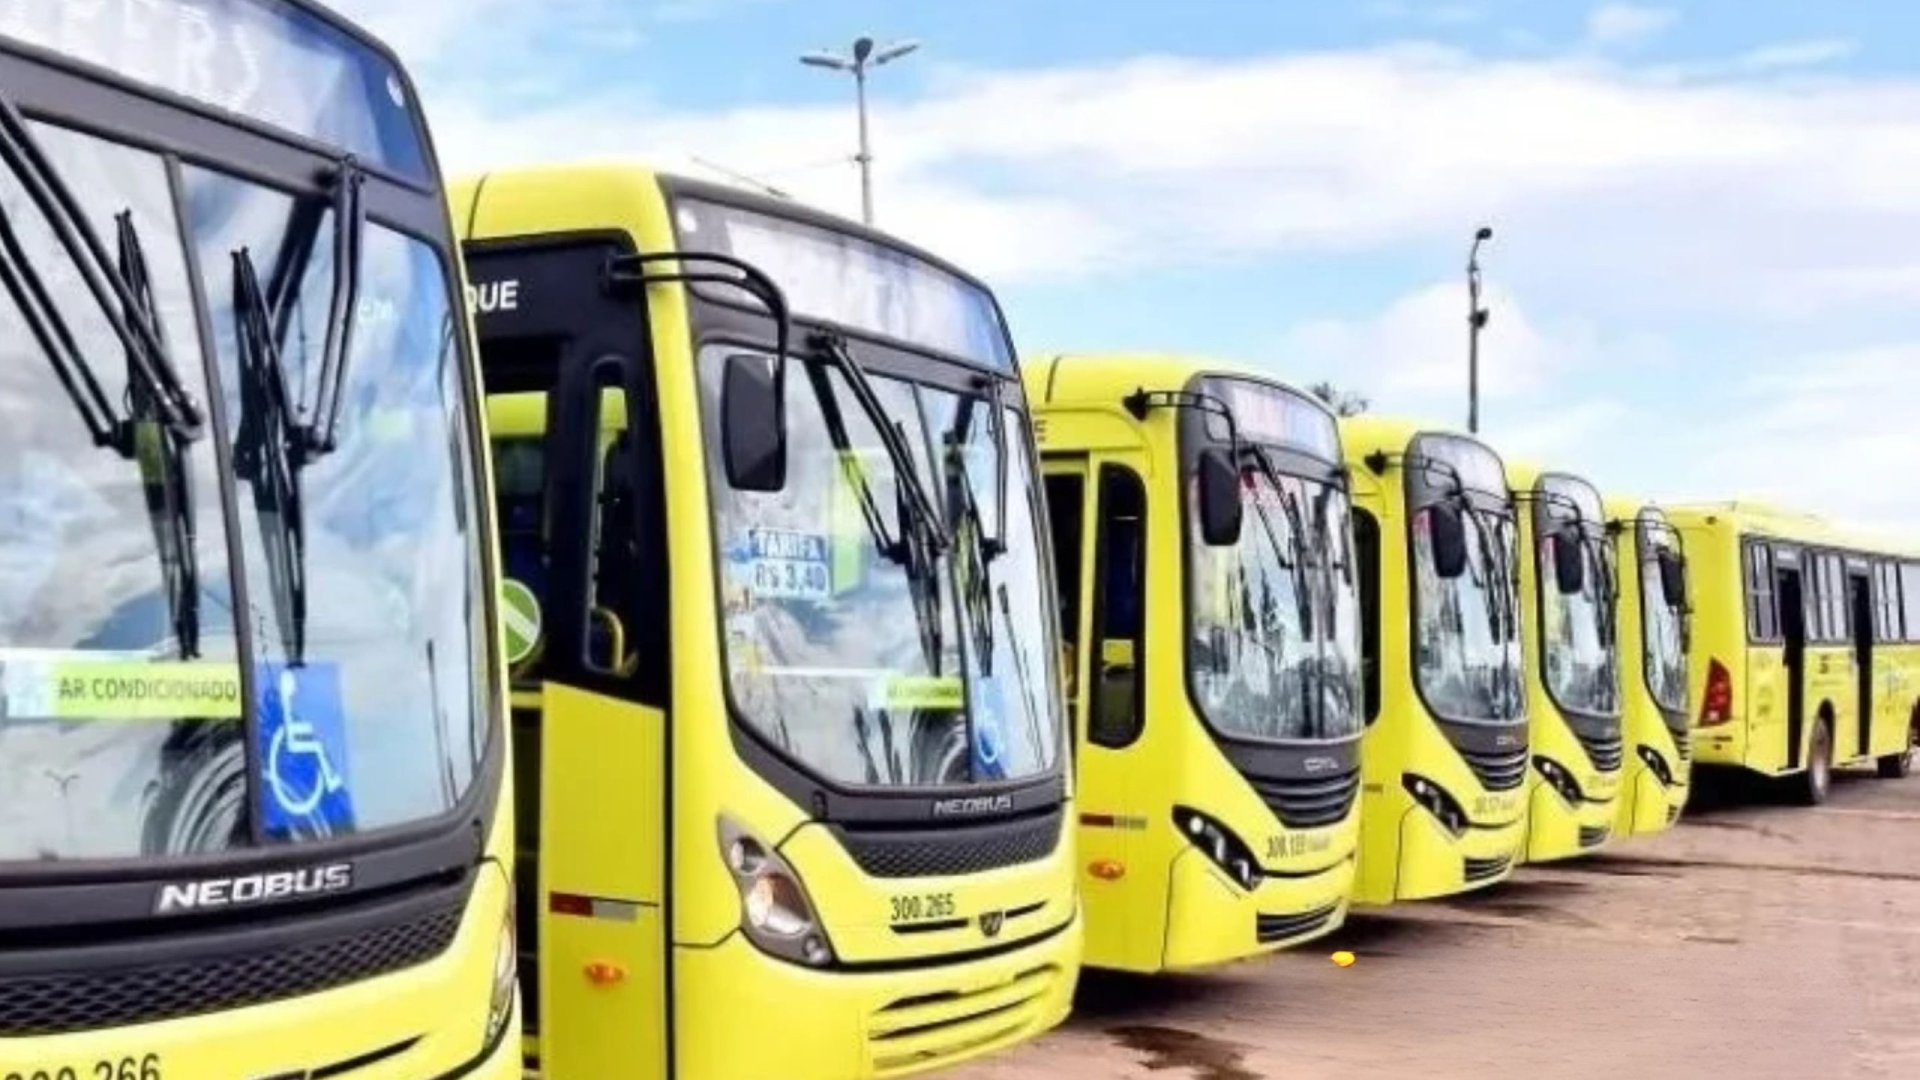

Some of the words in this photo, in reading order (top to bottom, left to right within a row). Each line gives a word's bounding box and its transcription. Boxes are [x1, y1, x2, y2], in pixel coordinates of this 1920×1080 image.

[60, 678, 85, 700] AR
[92, 678, 237, 701] CONDICIONADO
[934, 794, 1012, 817] NEOBUS
[158, 863, 351, 912] NEOBUS
[890, 893, 955, 921] 300.265
